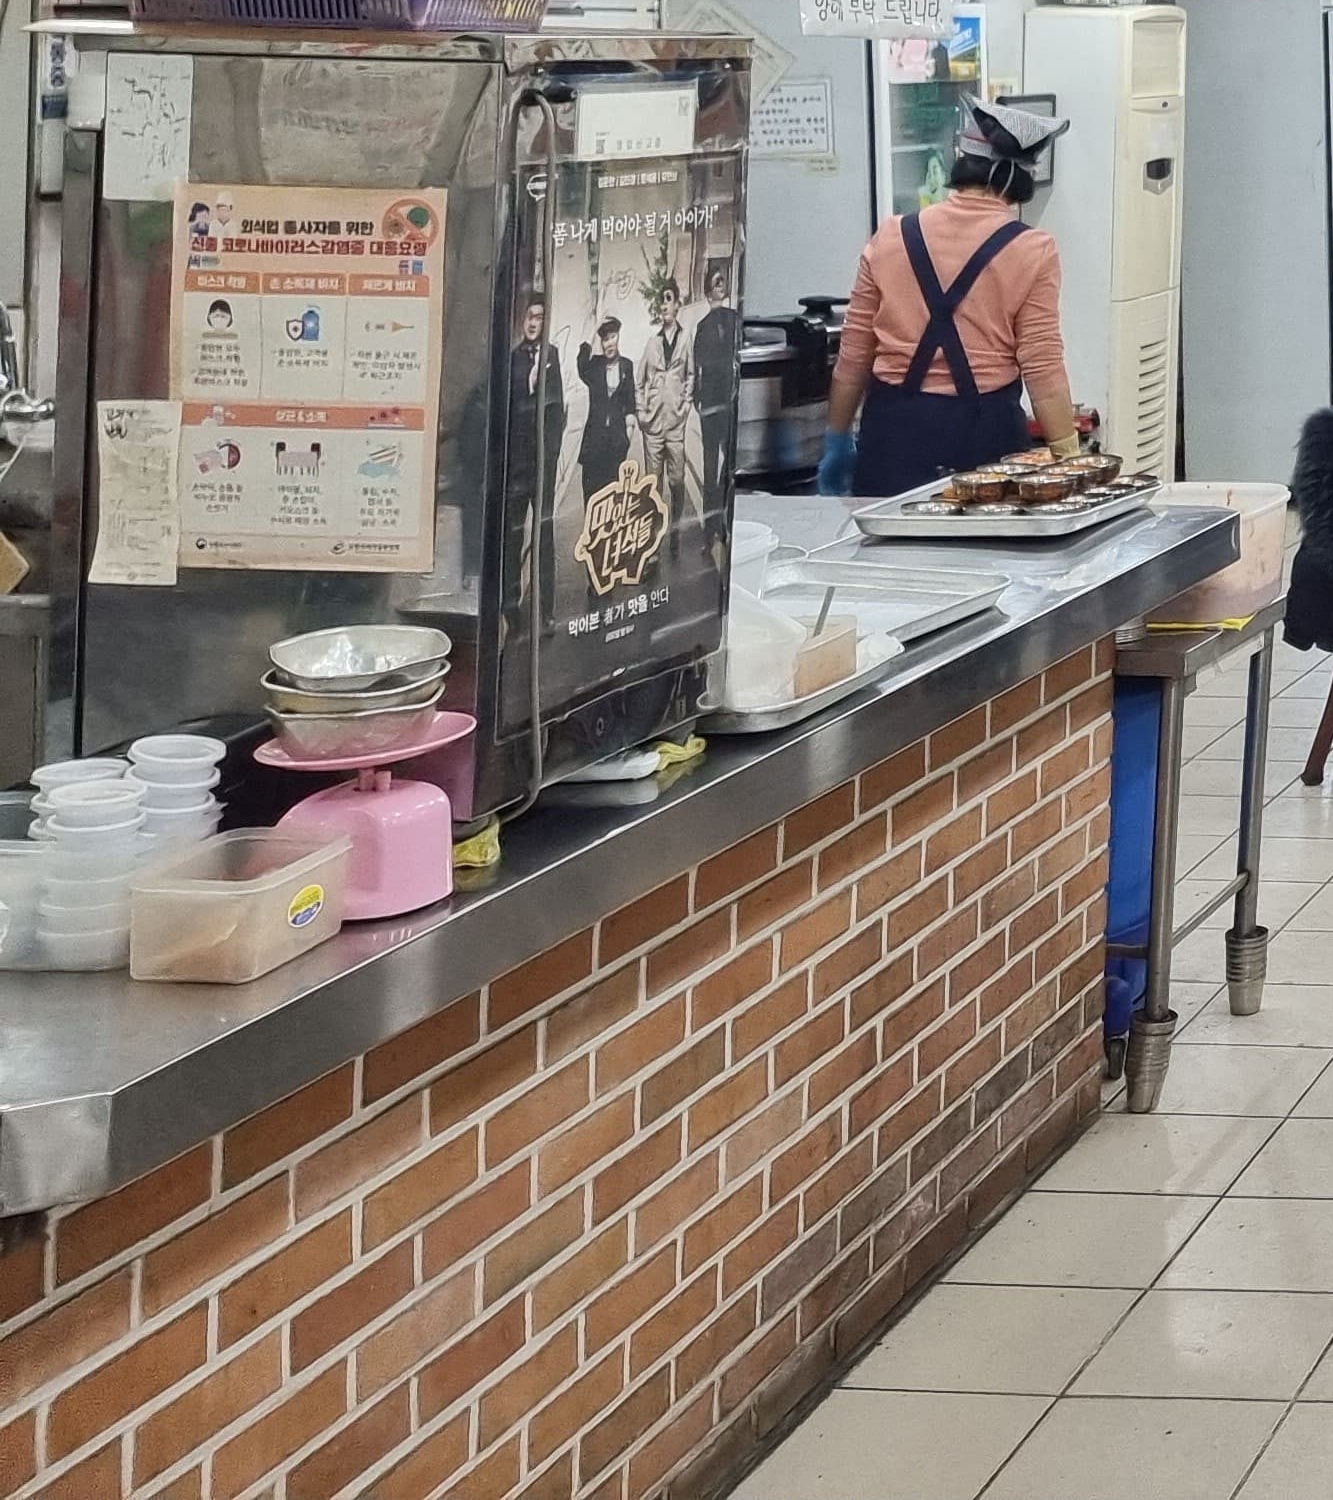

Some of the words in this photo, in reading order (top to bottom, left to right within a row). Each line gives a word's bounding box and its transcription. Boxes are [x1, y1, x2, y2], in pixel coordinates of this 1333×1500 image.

[241, 218, 280, 236] 외식업
[346, 220, 375, 237] 위한
[572, 217, 598, 245] 나게
[602, 212, 642, 241] 먹어야
[660, 209, 672, 235] 거
